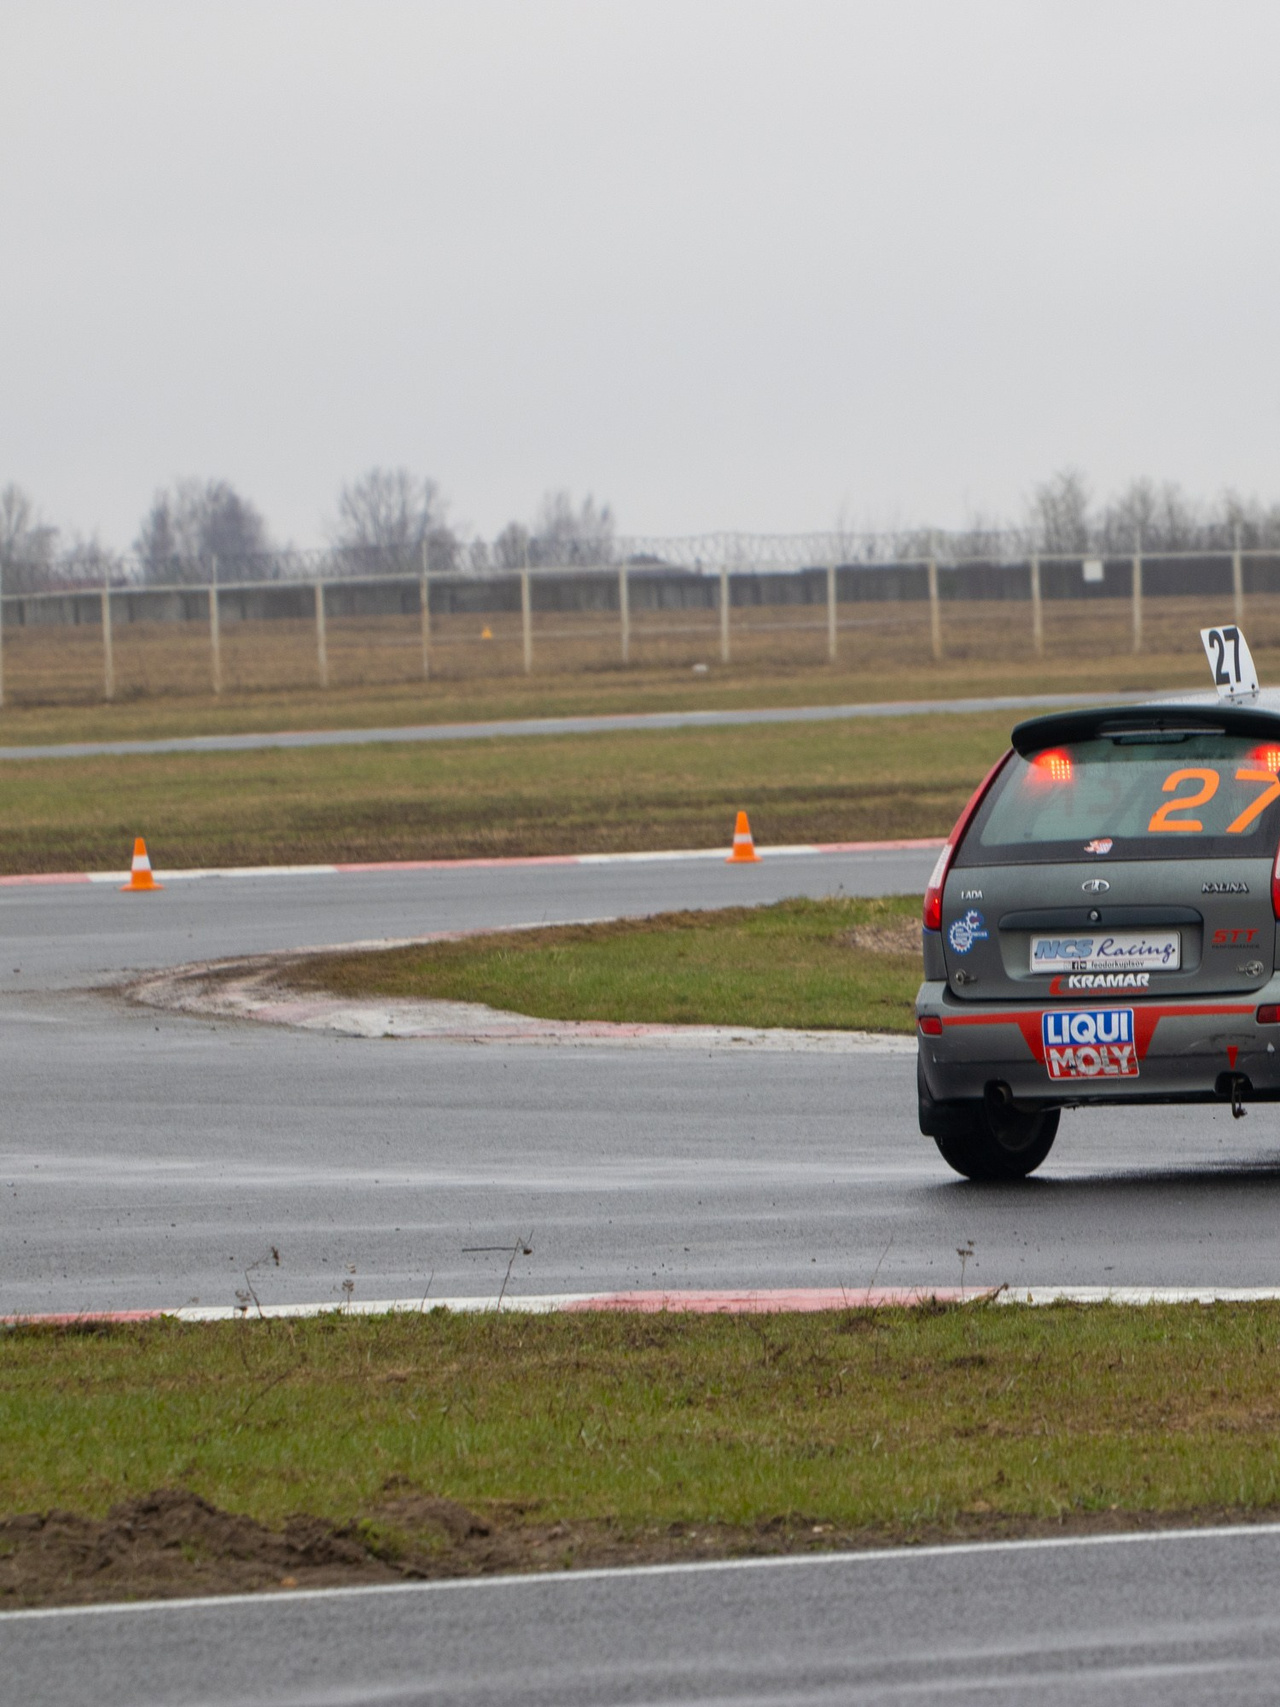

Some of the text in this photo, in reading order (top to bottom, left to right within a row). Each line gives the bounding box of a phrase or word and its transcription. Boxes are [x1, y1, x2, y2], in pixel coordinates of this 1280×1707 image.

[1208, 627, 1241, 686] 27
[961, 889, 984, 900] LADA
[1202, 882, 1250, 894] KALINA
[1212, 928, 1260, 943] STT
[1034, 938, 1173, 963] NCS Racing
[1068, 973, 1150, 988] KRAMAR
[1047, 1012, 1129, 1044] LIQUI
[1049, 1046, 1132, 1076] MOLY
